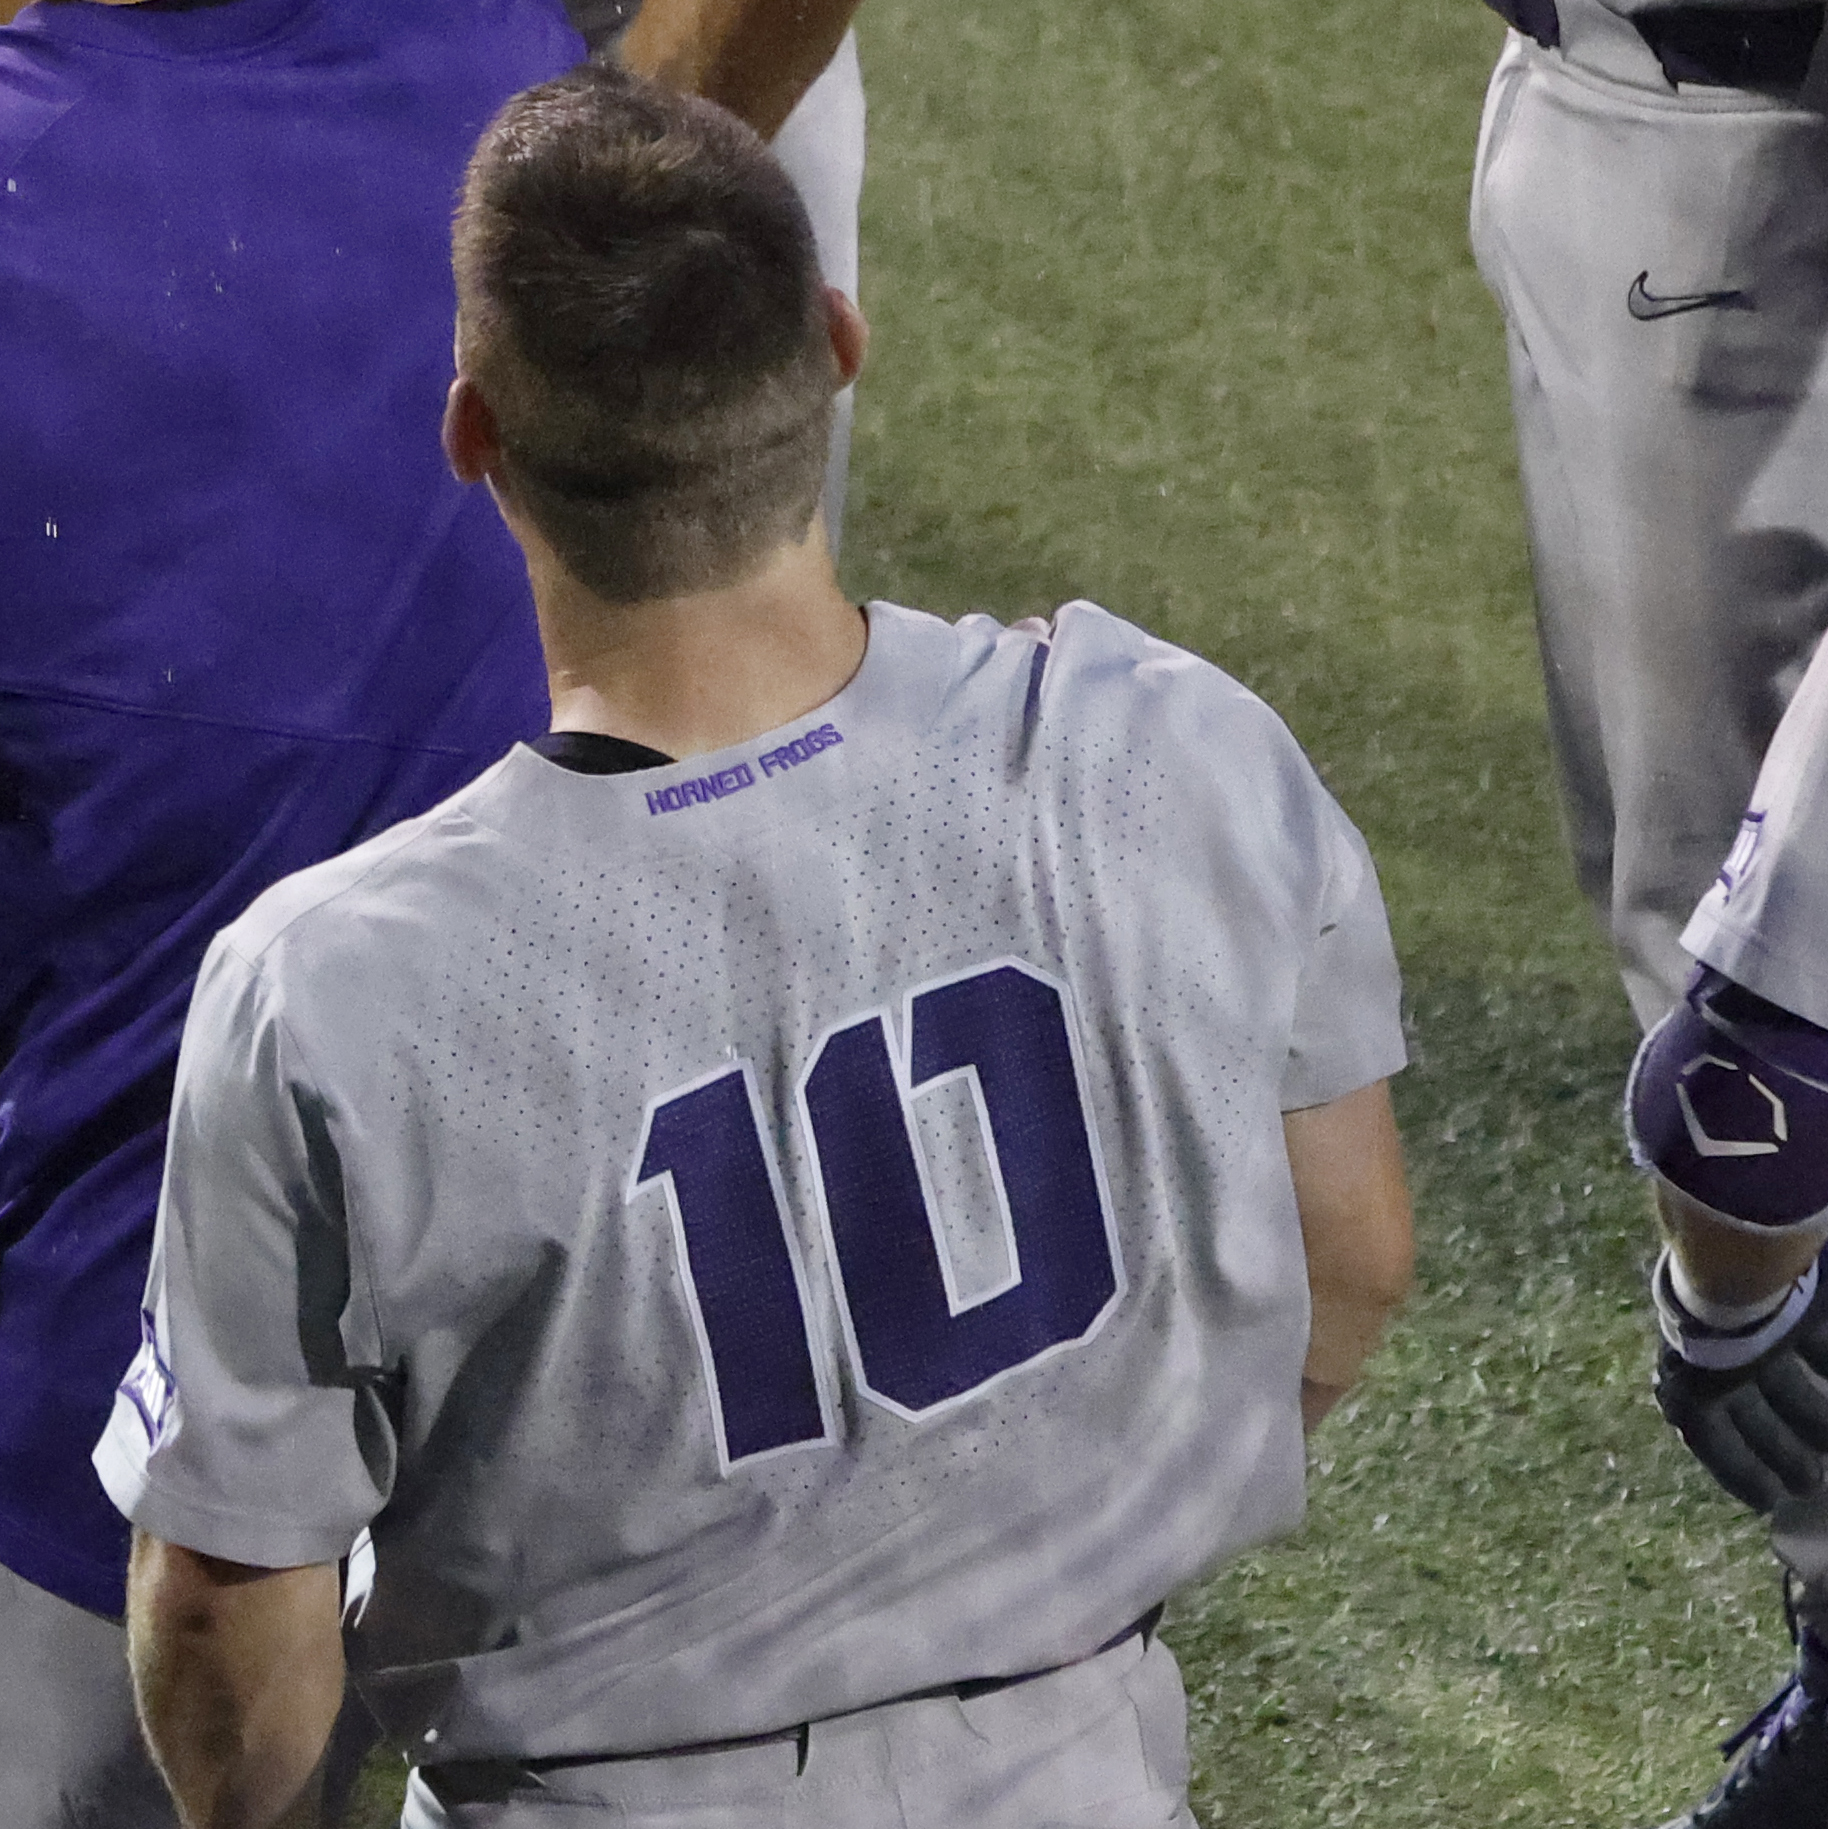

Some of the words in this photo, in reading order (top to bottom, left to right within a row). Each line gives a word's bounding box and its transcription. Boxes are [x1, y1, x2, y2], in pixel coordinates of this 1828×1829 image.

[644, 762, 755, 816] HORNED
[758, 723, 844, 778] FROGS
[627, 956, 1129, 1479] 10
